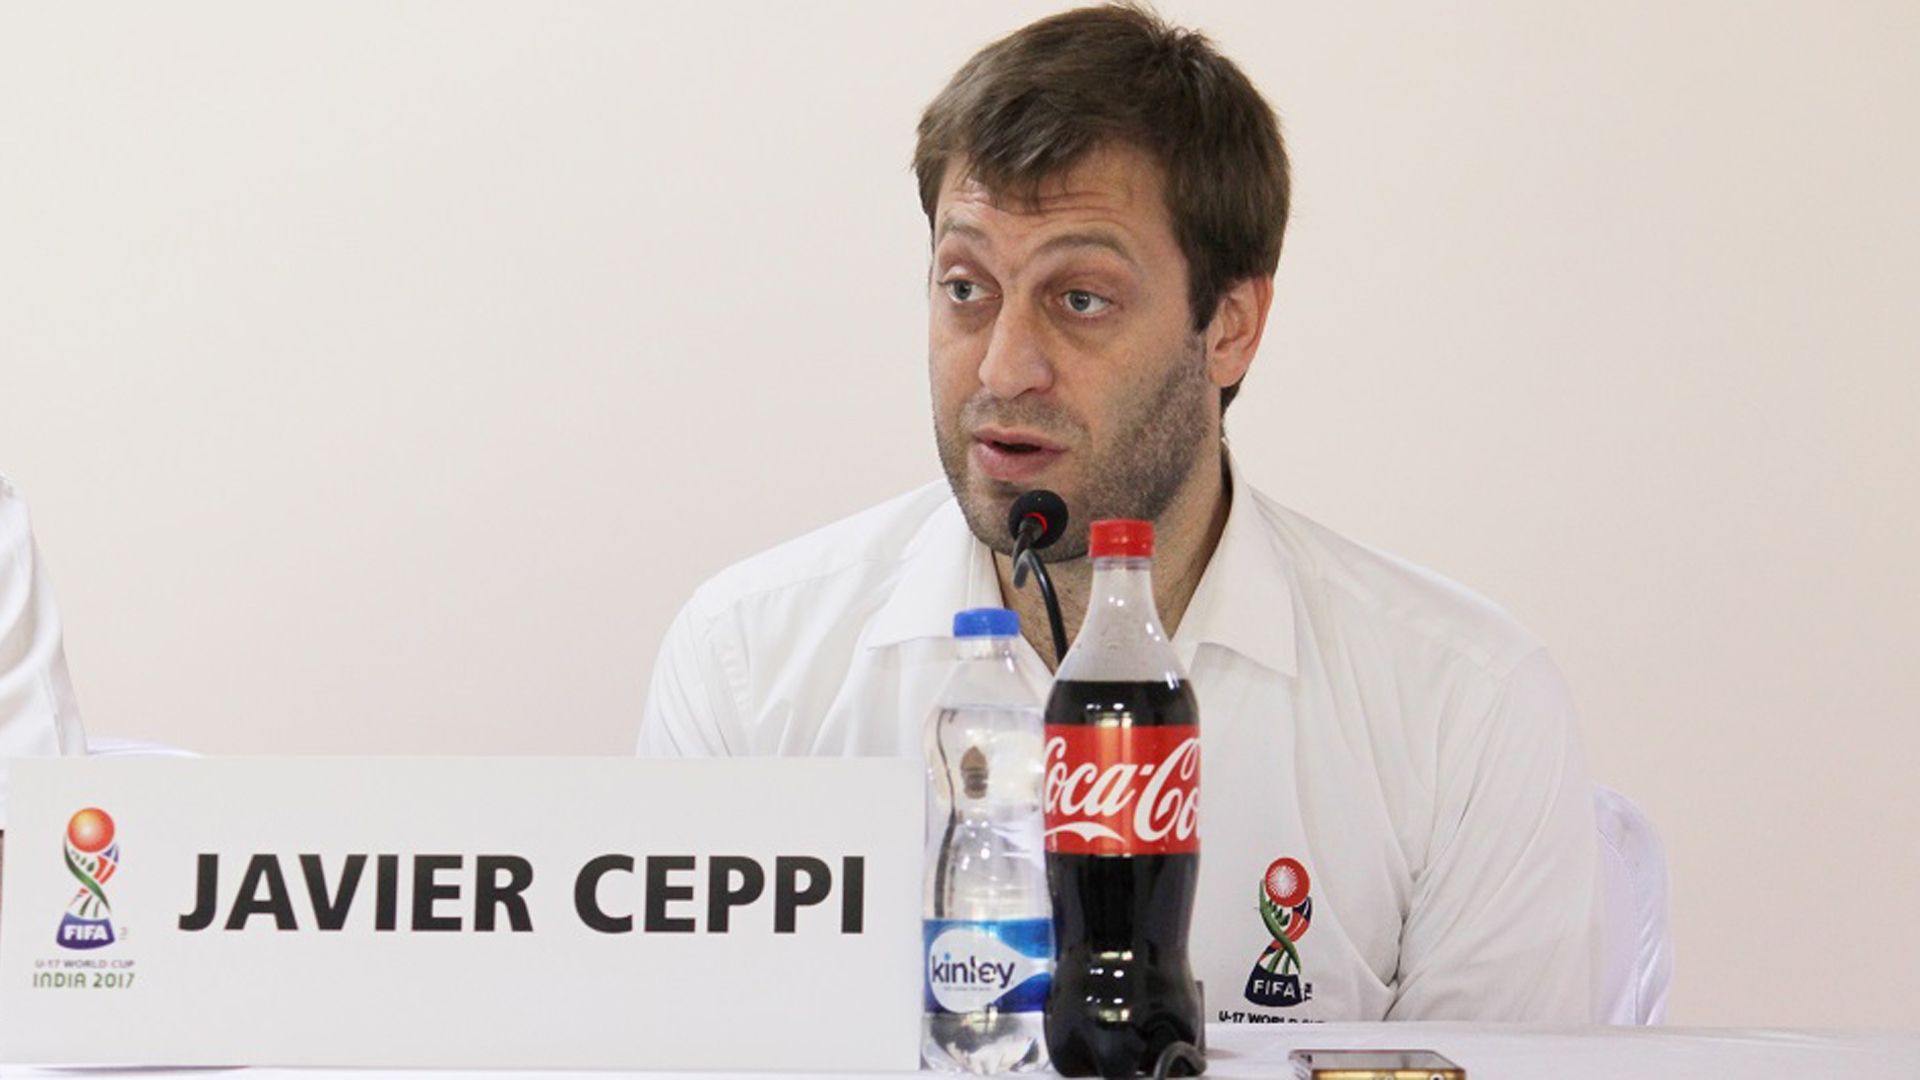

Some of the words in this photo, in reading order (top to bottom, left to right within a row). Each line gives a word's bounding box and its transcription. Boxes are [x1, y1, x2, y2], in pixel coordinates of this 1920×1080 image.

[179, 854, 533, 932] JAVIER
[574, 854, 865, 934] CEPPI
[64, 924, 109, 941] FIFA
[35, 960, 61, 969] U-17
[64, 960, 108, 969] WORLD
[111, 960, 135, 969] CUP
[932, 953, 1016, 989] kinley
[33, 973, 87, 988] INDIA
[93, 973, 135, 989] 2017
[1253, 979, 1296, 999] FIFA
[1218, 1010, 1245, 1024] U-17
